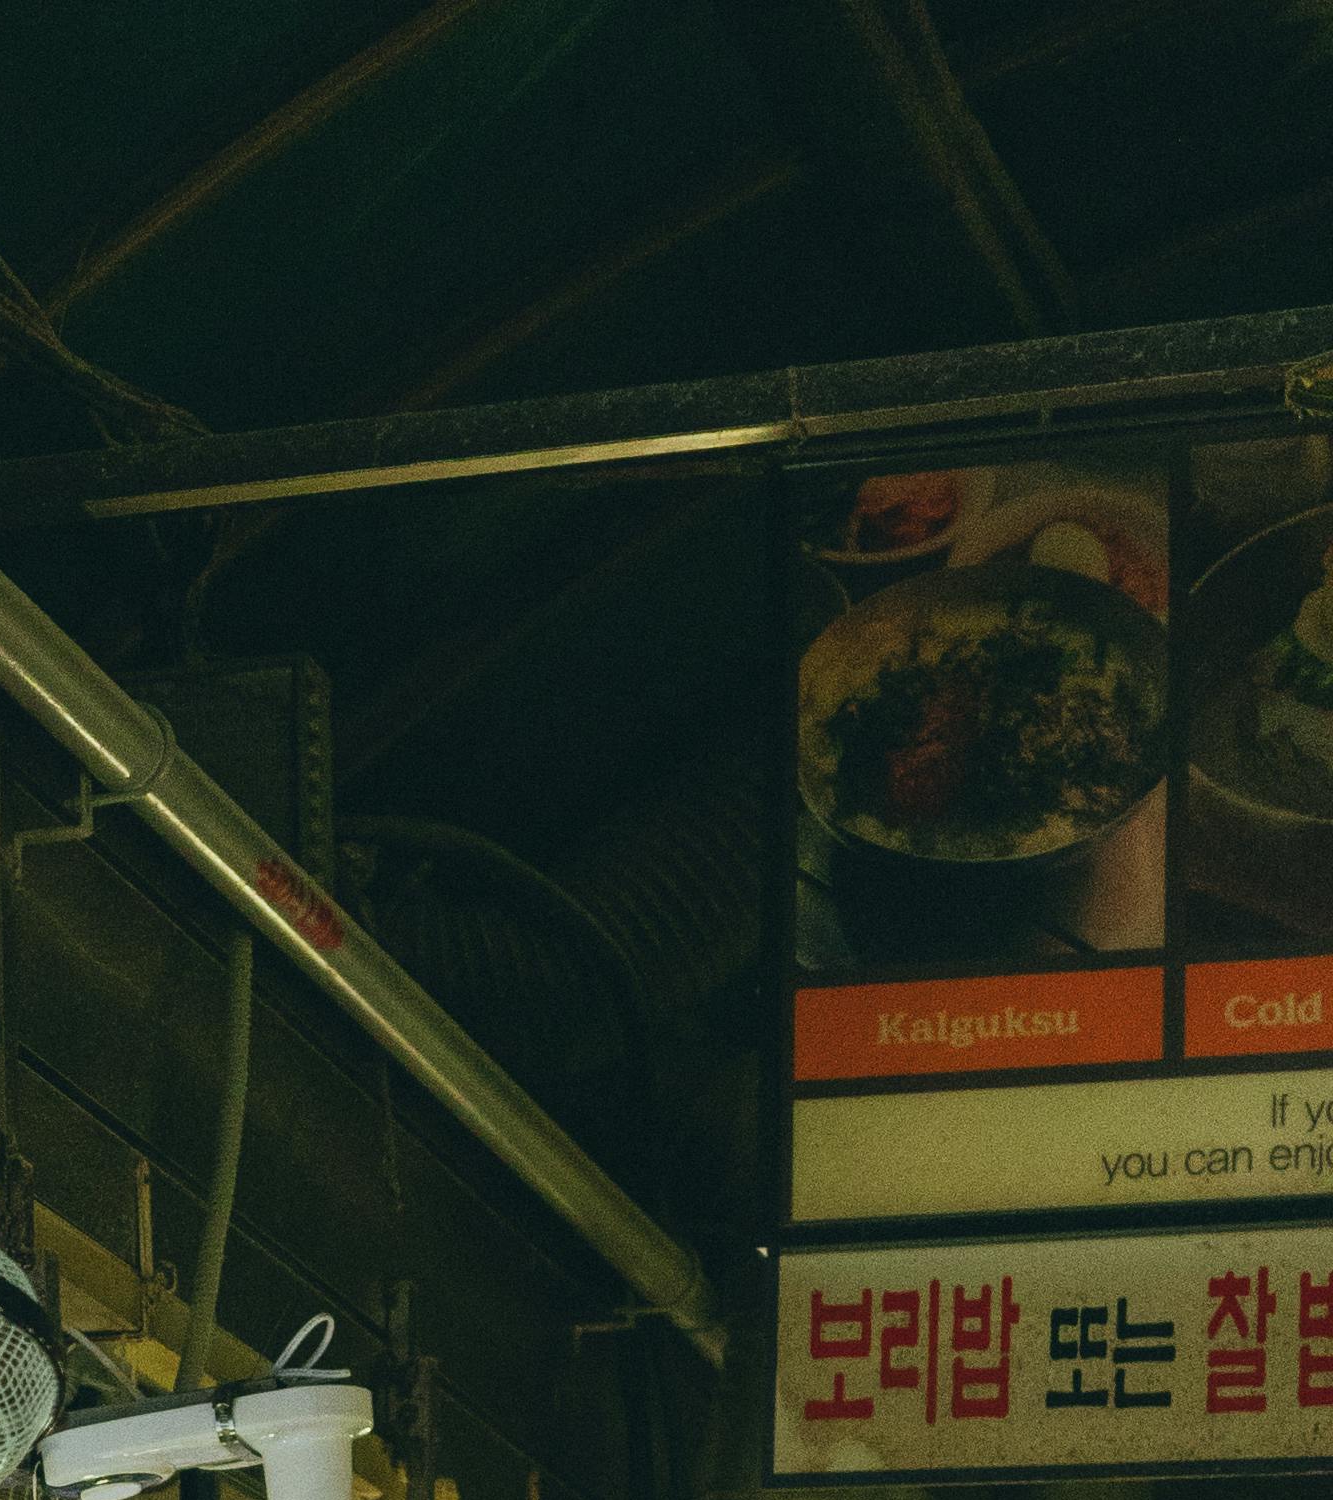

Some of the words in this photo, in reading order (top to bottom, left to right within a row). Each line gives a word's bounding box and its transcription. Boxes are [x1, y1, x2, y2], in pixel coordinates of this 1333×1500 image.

[877, 1005, 1080, 1048] Kalguksu
[1224, 990, 1324, 1030] Cold
[1271, 1094, 1290, 1128] If
[1102, 1150, 1169, 1184] you
[1185, 1143, 1253, 1176] can
[804, 1275, 1020, 1424] 보리밥
[1045, 1297, 1175, 1410] 또는
